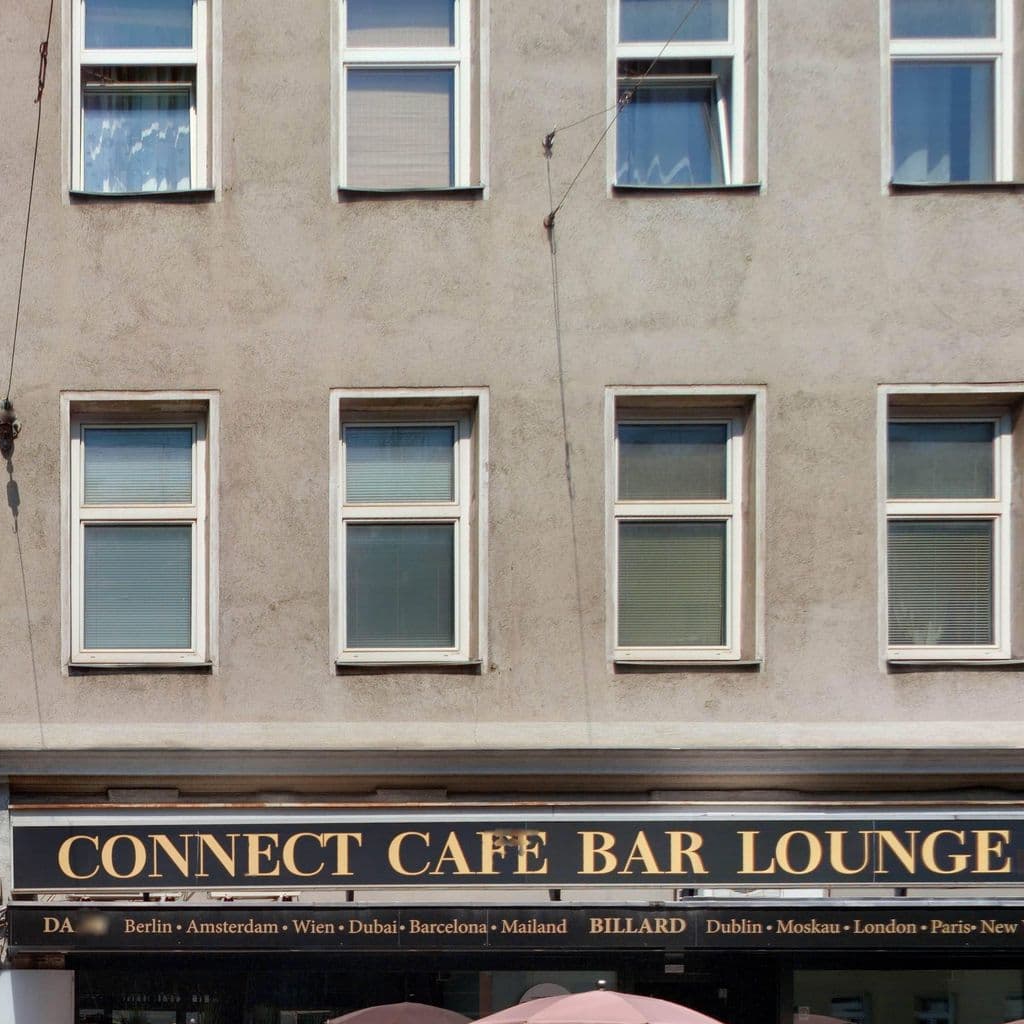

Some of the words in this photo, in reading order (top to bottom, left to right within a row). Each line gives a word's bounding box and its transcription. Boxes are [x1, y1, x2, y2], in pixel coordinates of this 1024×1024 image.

[57, 832, 363, 880] CONNECT
[388, 830, 549, 877] CAFE
[577, 830, 710, 875] BAR
[736, 829, 1012, 875] LOUNGE
[124, 918, 173, 934] Berlin
[186, 918, 279, 934] Amsterdam
[291, 918, 335, 934] Wien
[348, 918, 399, 934] Dubai
[409, 918, 488, 934] Barcelona
[501, 918, 568, 934] Mailand
[589, 917, 687, 934] BILLARD
[706, 918, 763, 934] Dublin
[776, 918, 841, 934] Moskau
[853, 918, 917, 934] London
[930, 918, 971, 934] Paris
[980, 918, 1018, 934] New
